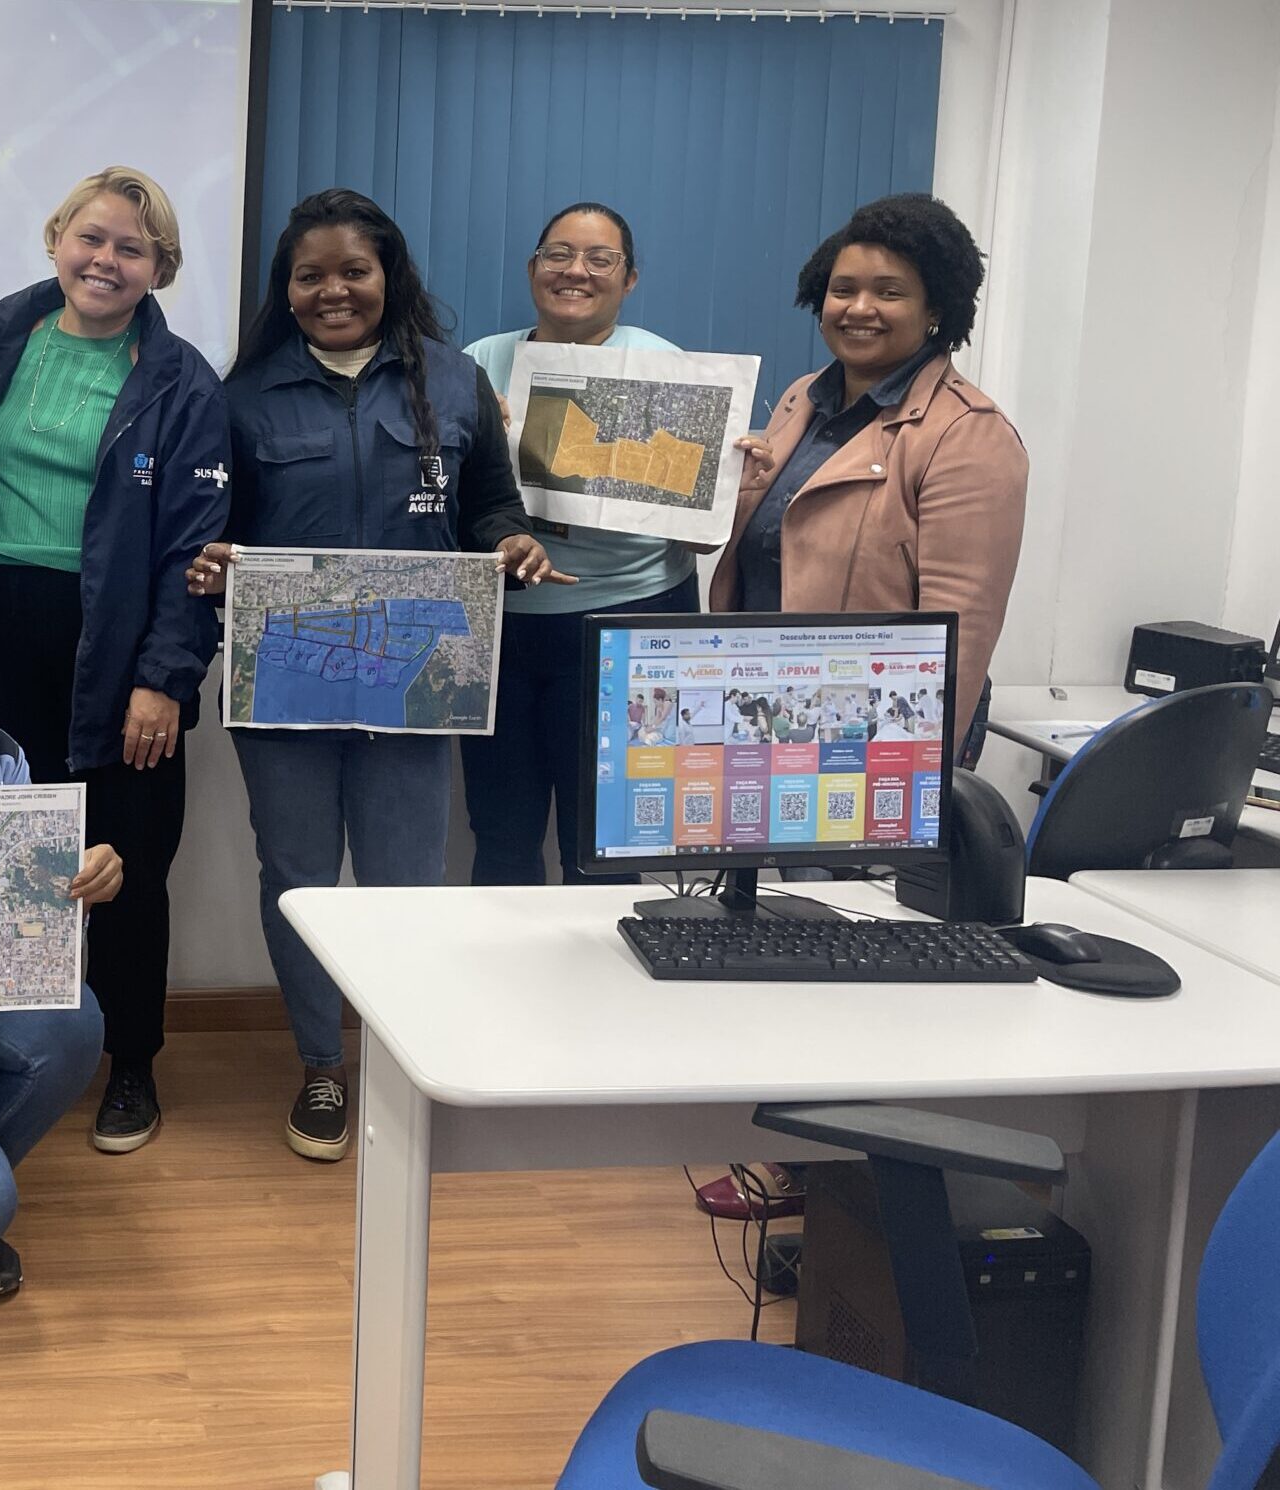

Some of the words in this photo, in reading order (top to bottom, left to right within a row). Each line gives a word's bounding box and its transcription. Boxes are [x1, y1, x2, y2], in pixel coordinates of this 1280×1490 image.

[194, 468, 212, 478] SUS
[409, 492, 435, 501] SAÚD
[408, 502, 446, 513] AGENT
[780, 633, 815, 641] Descubra
[855, 632, 893, 640] Otics-Rio!
[650, 639, 671, 649] RIO
[647, 670, 675, 679] SBVE
[786, 666, 820, 675] PBVM
